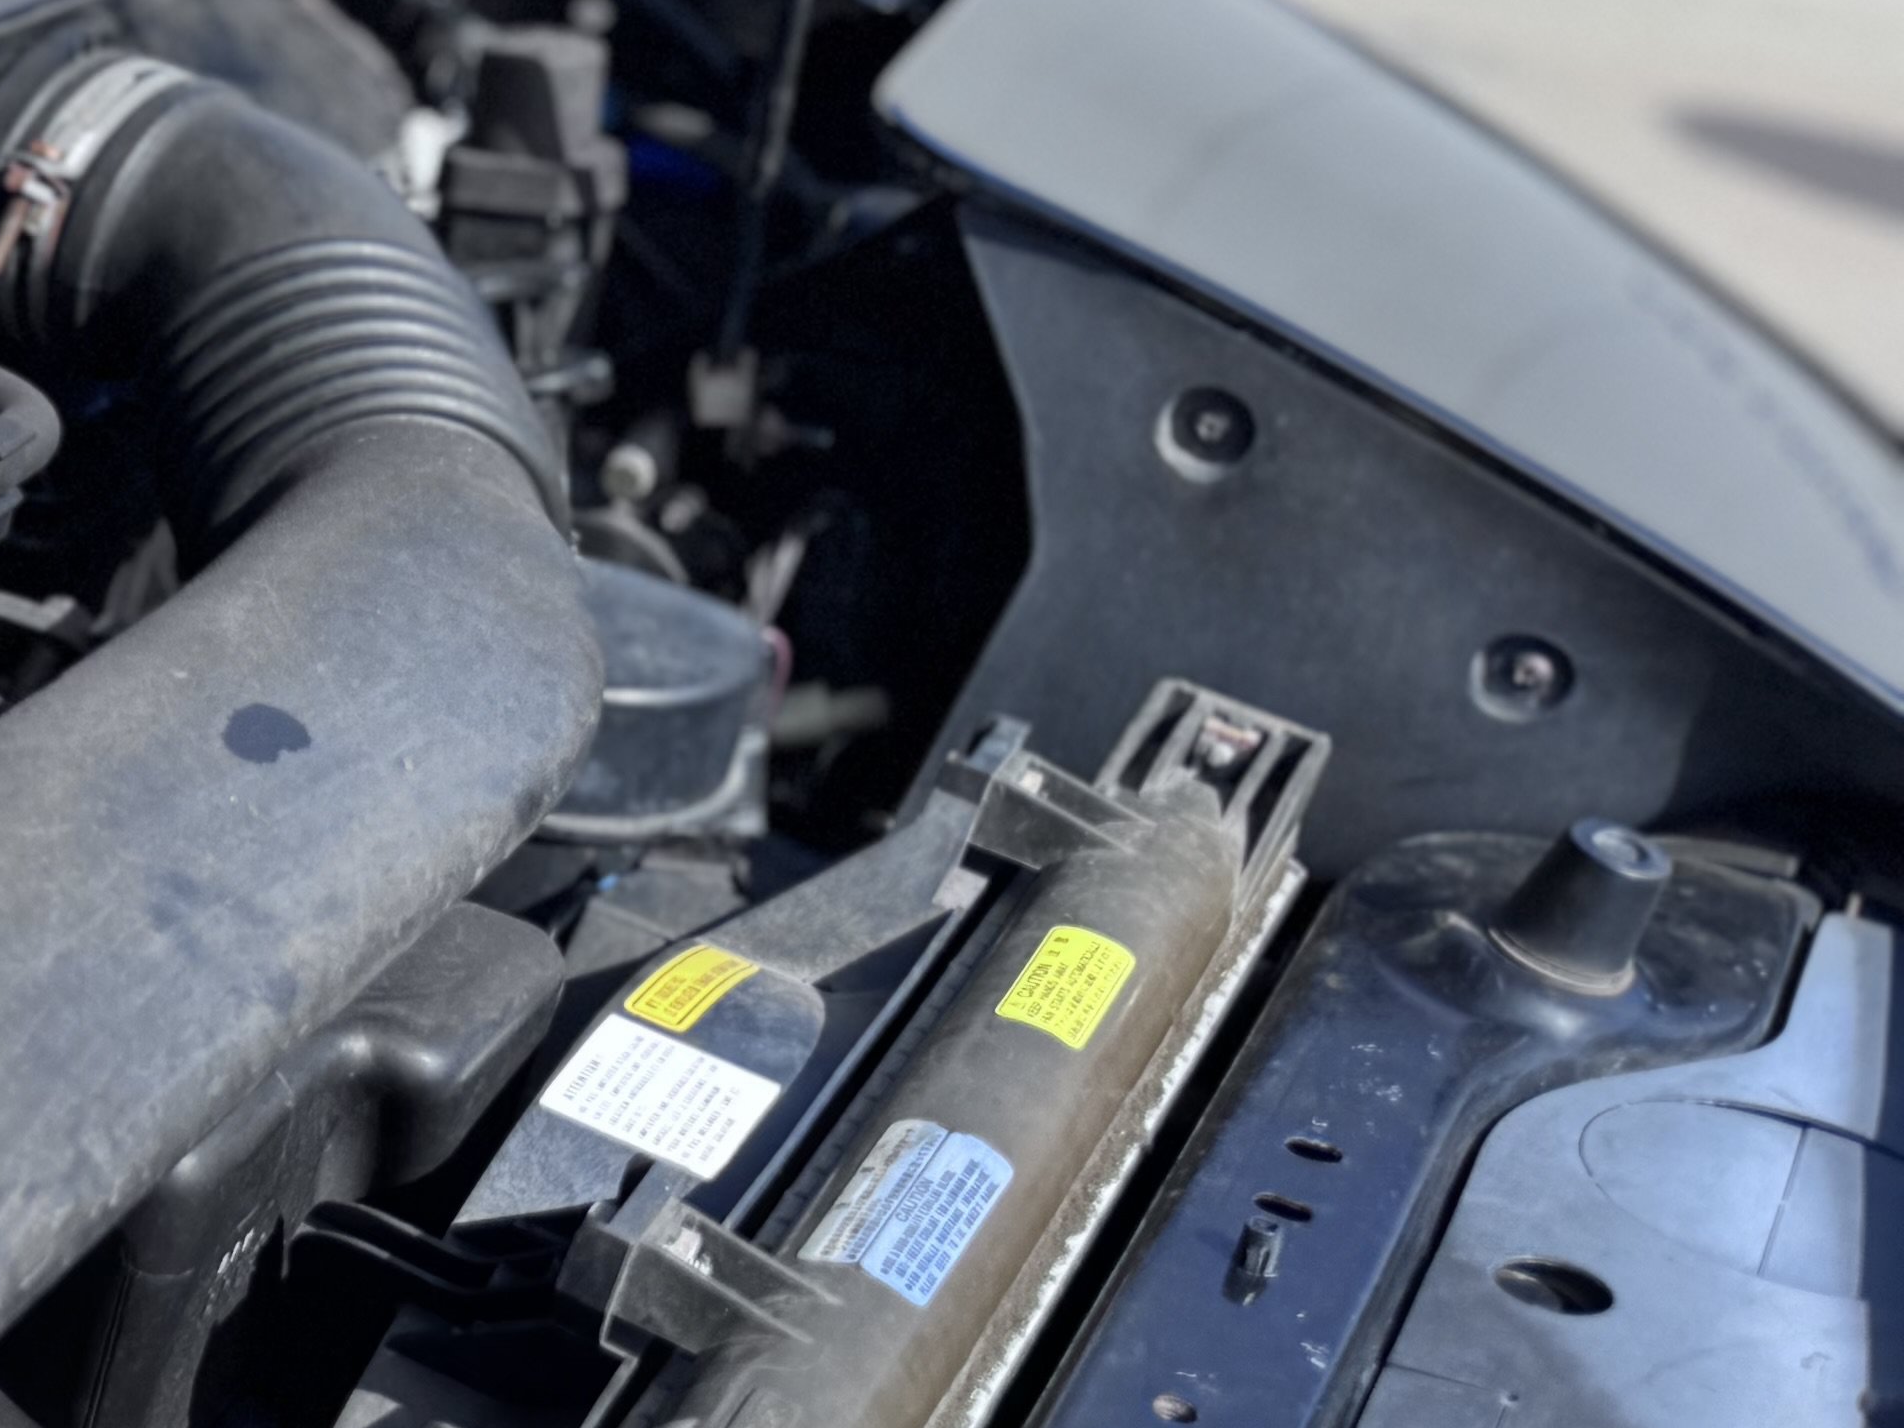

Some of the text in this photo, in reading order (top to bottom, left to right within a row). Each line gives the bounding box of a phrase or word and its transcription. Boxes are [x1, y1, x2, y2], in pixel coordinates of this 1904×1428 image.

[1016, 962, 1052, 998] CAUTION
[562, 1056, 601, 1102] ATTENTION
[894, 1177, 934, 1223] CAUTION
